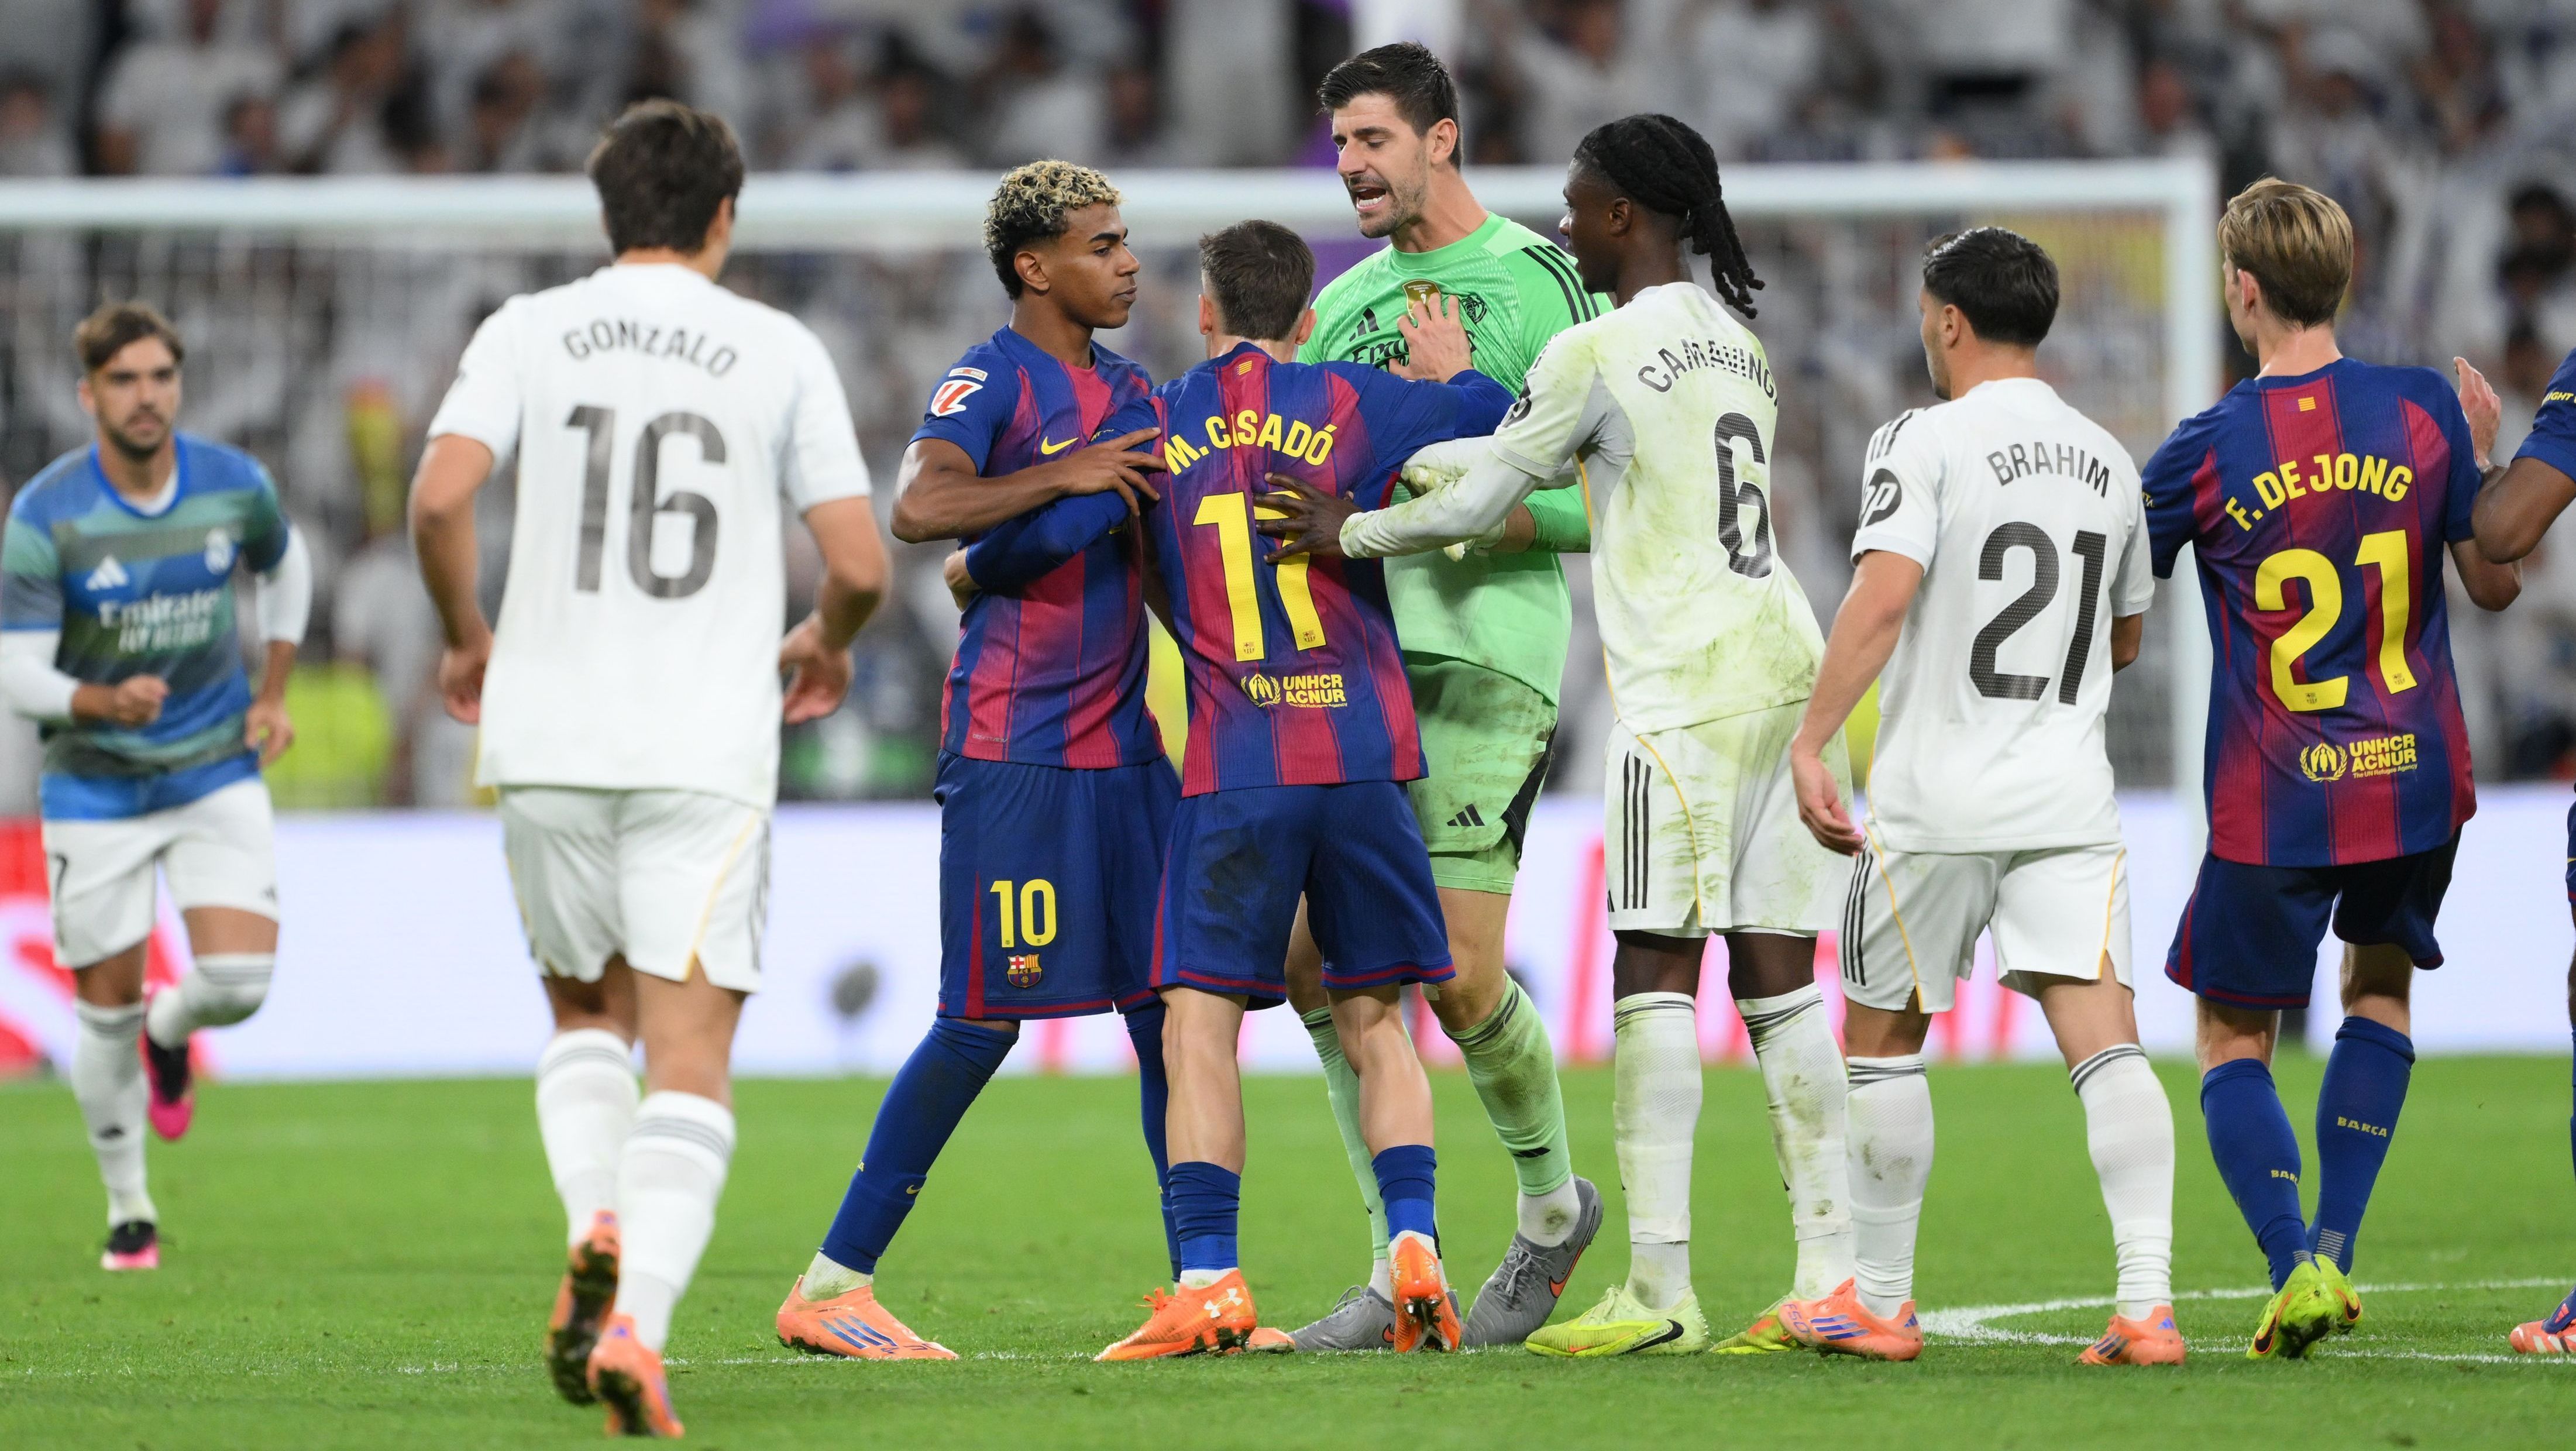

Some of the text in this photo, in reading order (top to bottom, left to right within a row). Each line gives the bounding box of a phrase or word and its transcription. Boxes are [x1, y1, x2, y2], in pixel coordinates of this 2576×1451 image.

[563, 319, 737, 378] GONZALO
[1638, 338, 1778, 407] CAMAVING
[1164, 410, 1337, 476] M. CSADÓ
[1986, 441, 2110, 498] BRAHIM
[565, 404, 727, 600] 16
[1714, 412, 1773, 579] 6
[2225, 496, 2263, 531] F.
[1969, 521, 2107, 706] 21
[2255, 529, 2417, 711] 21
[1282, 674, 1344, 690] UNHCR
[1285, 689, 1346, 704] ACNUR
[2349, 734, 2416, 757] UNHCR
[2351, 748, 2417, 772] ACNUR
[2374, 767, 2398, 776] Refugee
[2398, 764, 2417, 772] Agency
[989, 879, 1057, 948] 10
[2337, 1116, 2388, 1137] BARÇA
